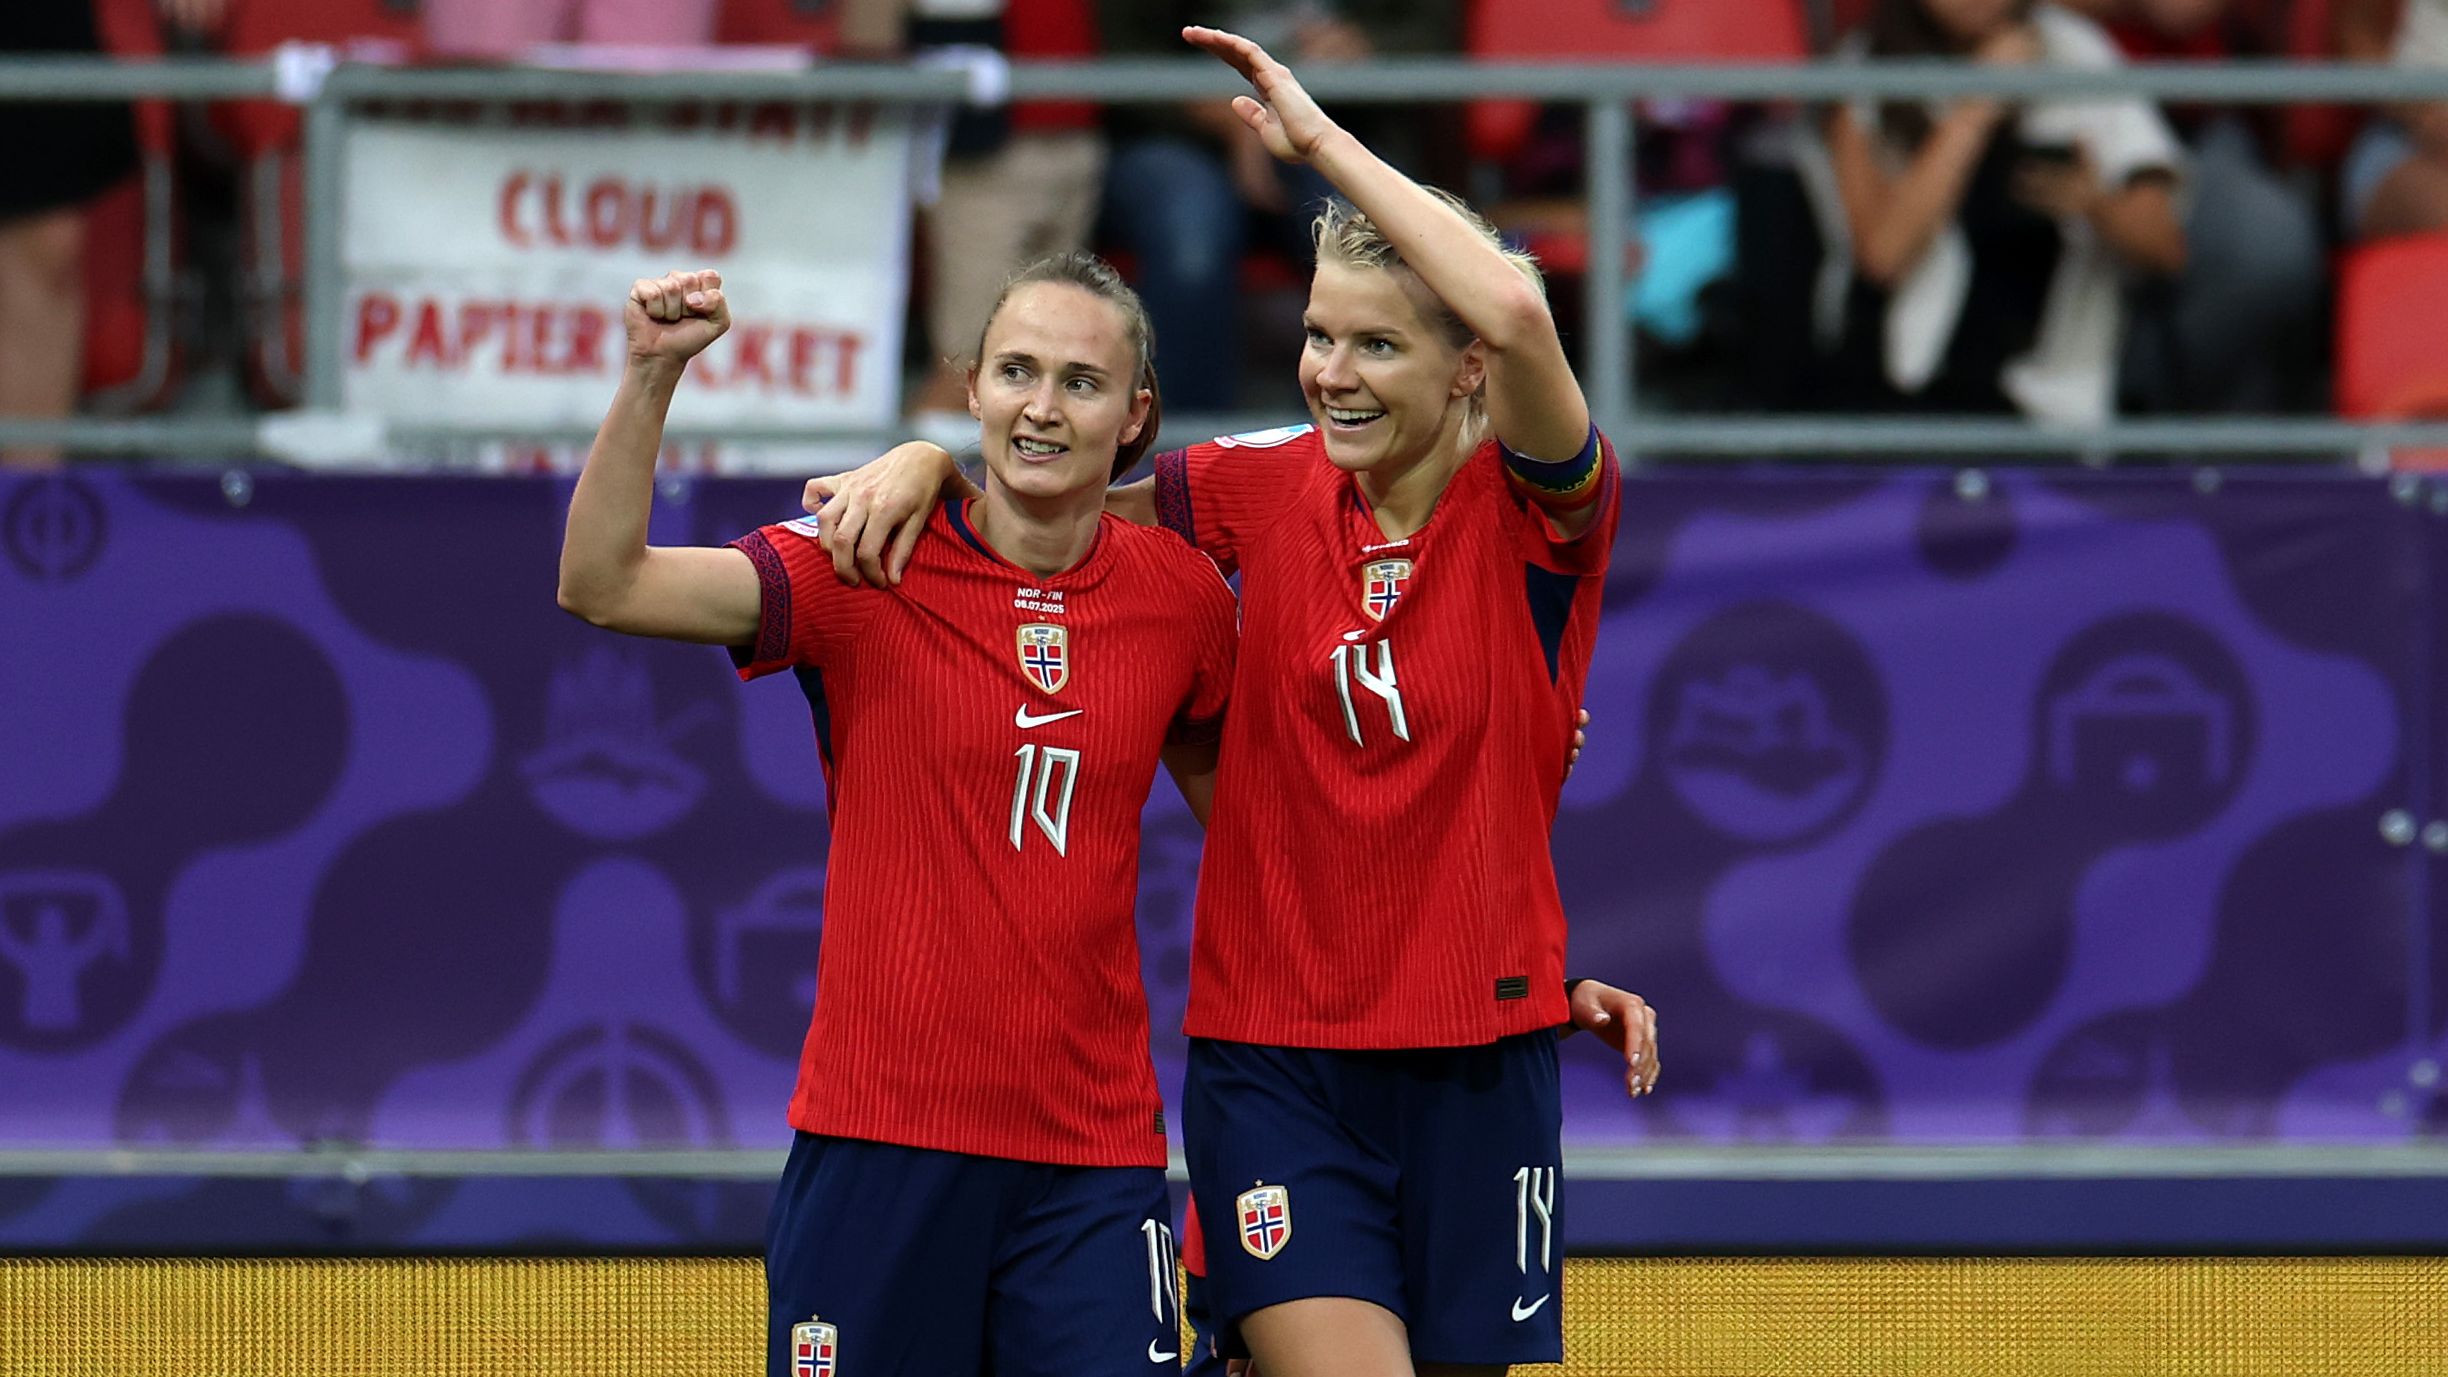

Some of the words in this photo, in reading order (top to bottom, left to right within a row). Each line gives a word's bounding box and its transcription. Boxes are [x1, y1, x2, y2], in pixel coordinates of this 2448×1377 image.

[497, 168, 740, 258] CLOUD
[1017, 587, 1041, 599] NOR
[1329, 639, 1410, 749] 14
[1009, 743, 1081, 858] 10
[1513, 1166, 1554, 1275] 14
